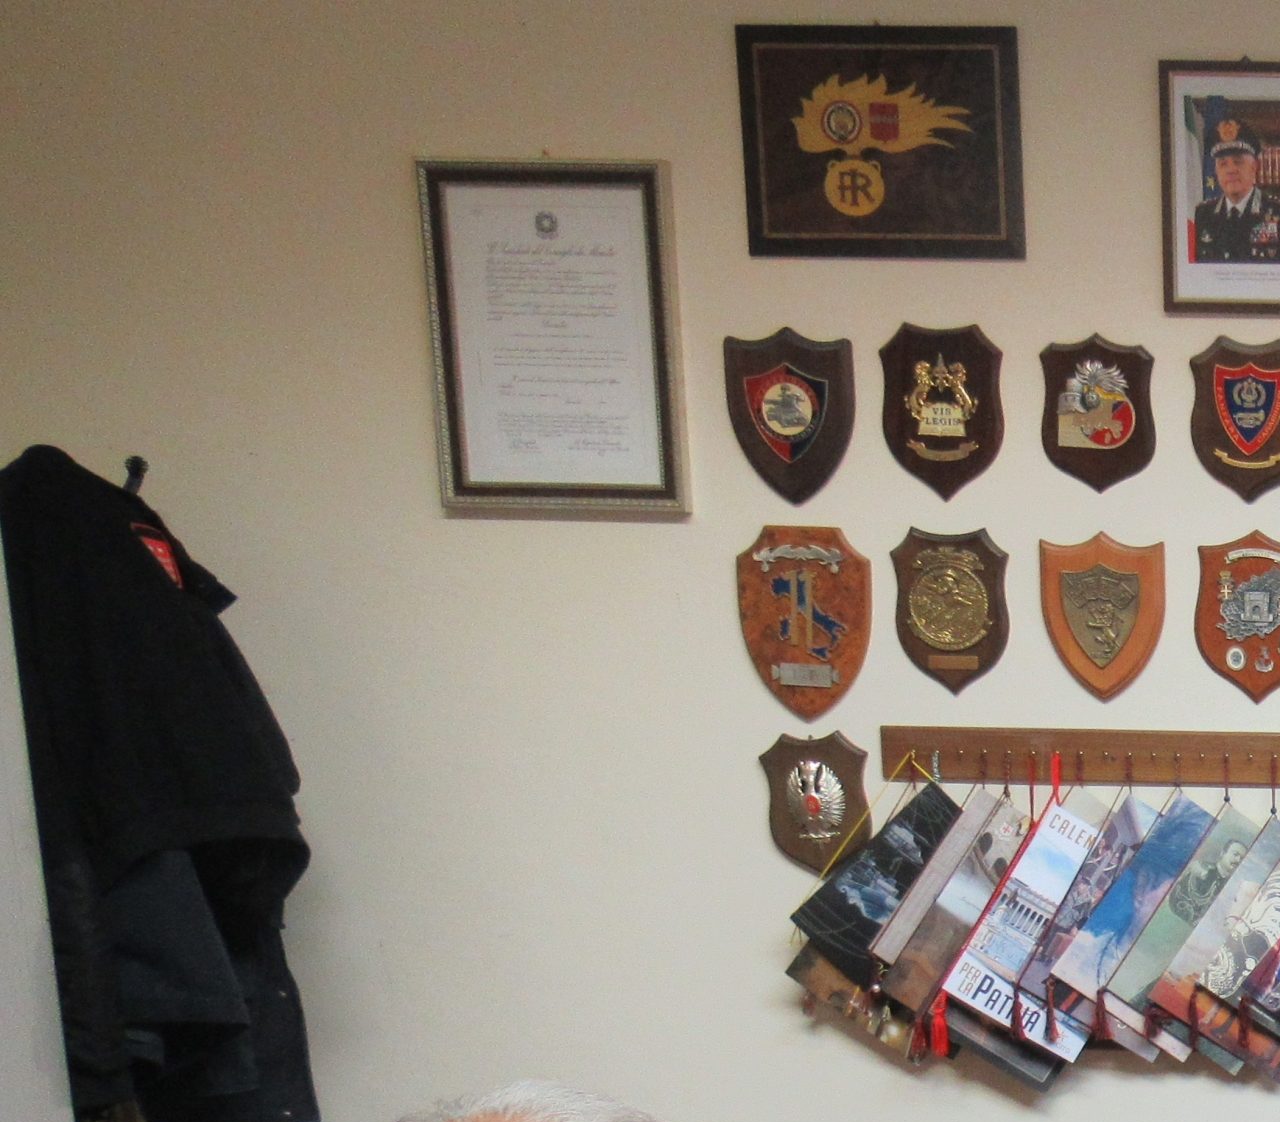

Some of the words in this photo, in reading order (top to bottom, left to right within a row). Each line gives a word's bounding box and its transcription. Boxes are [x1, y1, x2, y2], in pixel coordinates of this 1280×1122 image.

[932, 407, 952, 416] VIS
[925, 417, 960, 426] LEGIS
[959, 961, 982, 985] PER
[957, 978, 974, 997] LA
